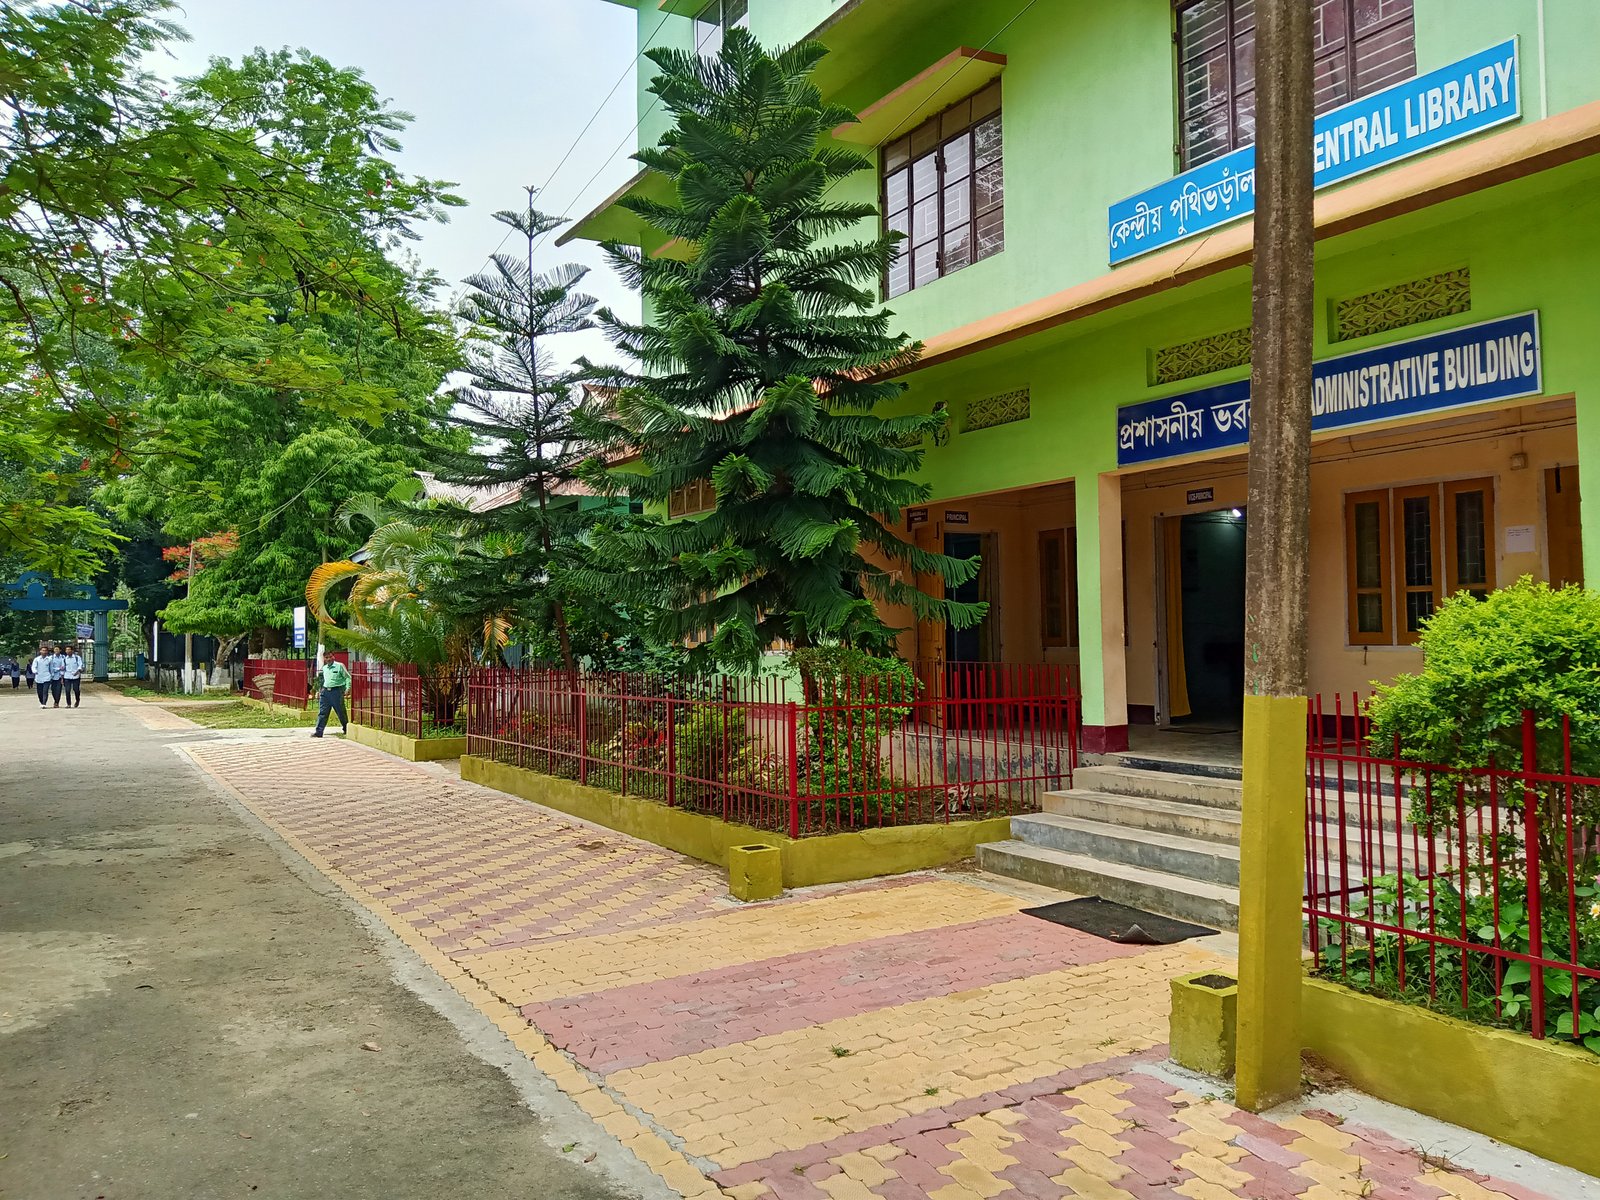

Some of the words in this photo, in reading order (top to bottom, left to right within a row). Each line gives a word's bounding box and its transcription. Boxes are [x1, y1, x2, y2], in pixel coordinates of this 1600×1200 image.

[1314, 105, 1398, 172] ENTRAL
[1404, 56, 1515, 138] LIBRARY
[1444, 331, 1535, 392] BUILDING
[946, 513, 968, 522] PRINCIPAL
